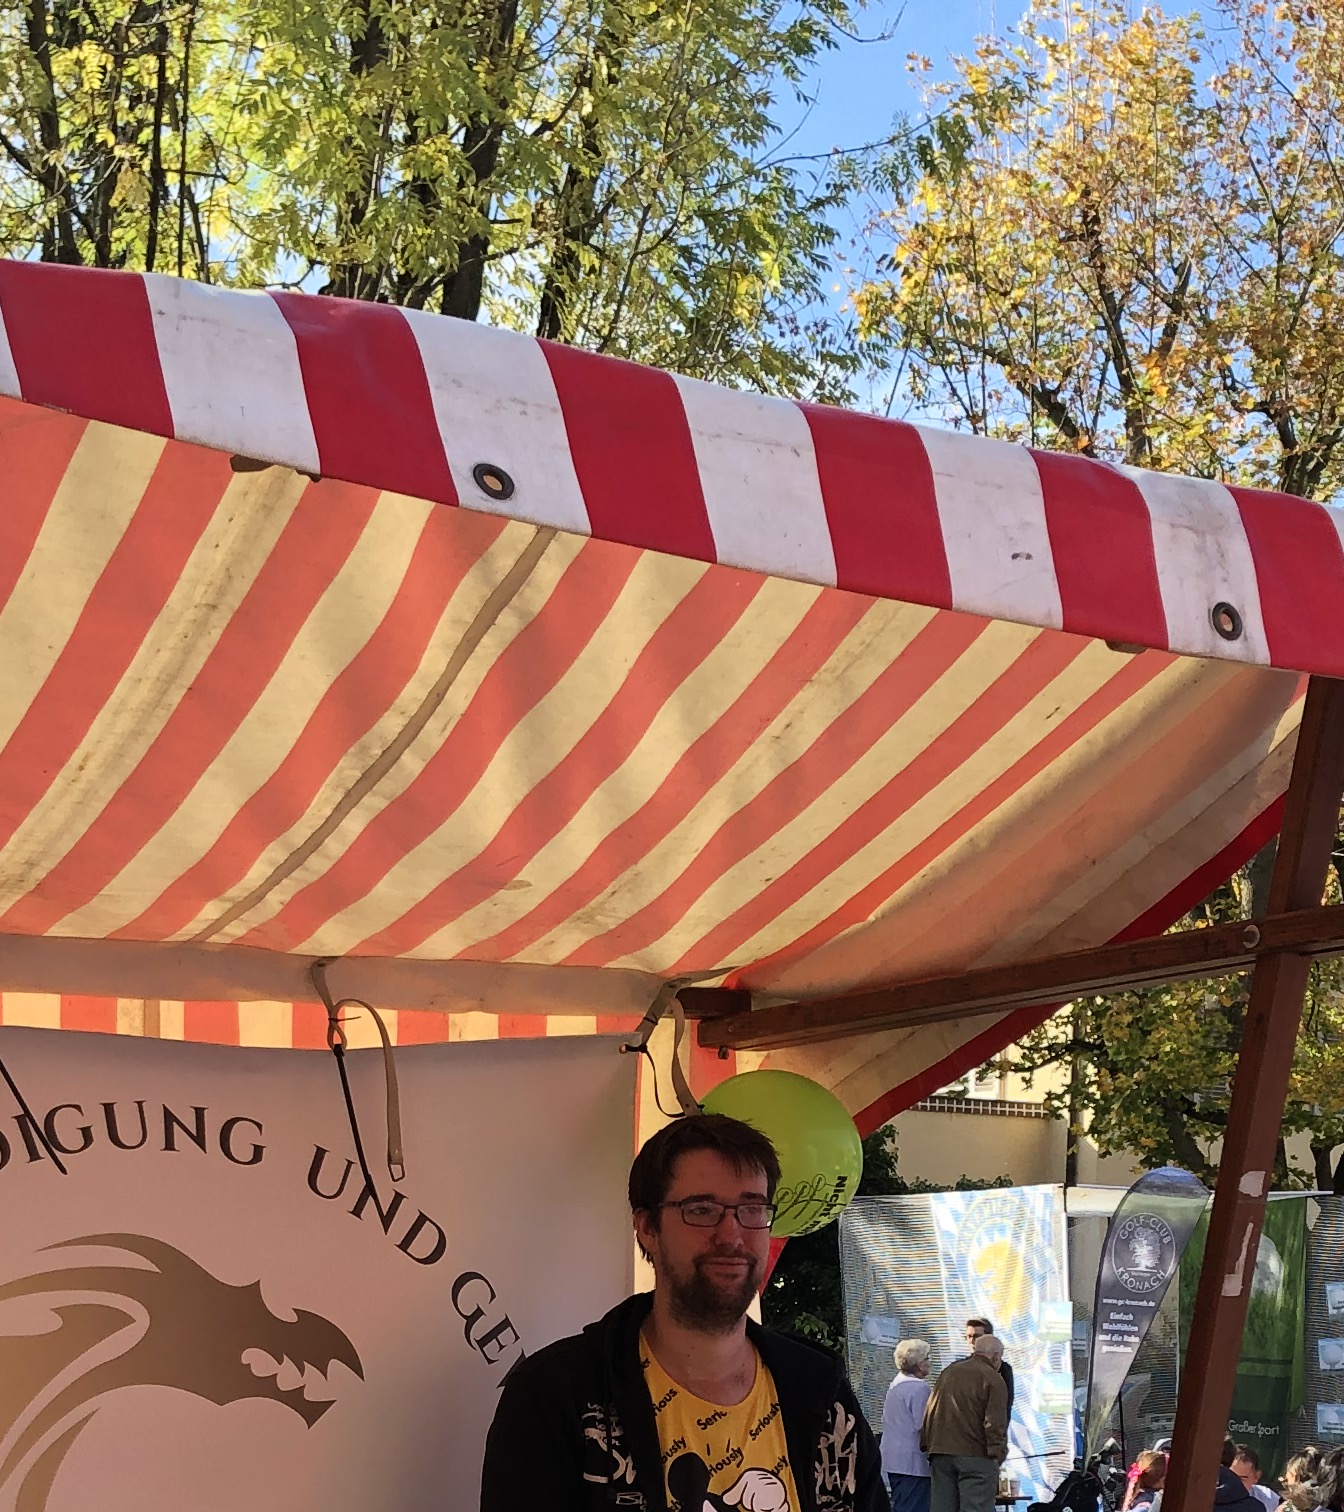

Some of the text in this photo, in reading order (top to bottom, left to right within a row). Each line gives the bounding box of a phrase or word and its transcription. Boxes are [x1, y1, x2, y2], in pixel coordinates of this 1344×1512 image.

[1119, 1214, 1172, 1245] GOLF-CLUB
[307, 1144, 447, 1266] UND
[451, 1271, 526, 1390] GE
[1116, 1266, 1167, 1291] KRONACH
